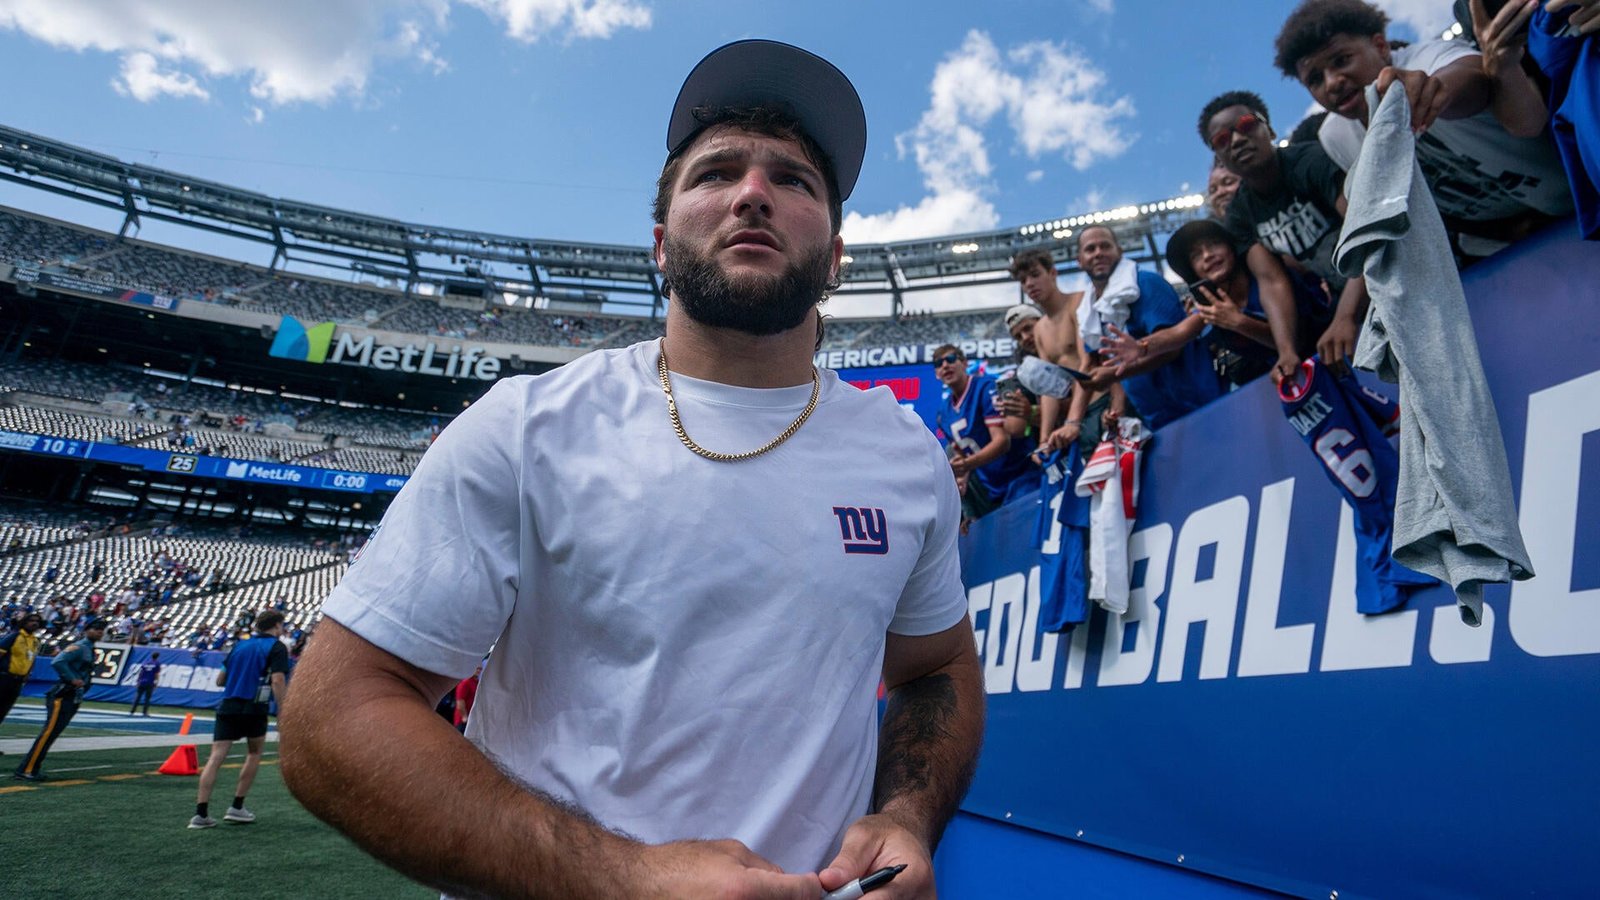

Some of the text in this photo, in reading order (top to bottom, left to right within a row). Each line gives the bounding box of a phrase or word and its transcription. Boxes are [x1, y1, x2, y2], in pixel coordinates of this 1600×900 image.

[331, 332, 501, 380] MetLife
[813, 345, 918, 370] MERICAN
[1288, 392, 1334, 437] DART
[42, 439, 66, 453] 10
[171, 457, 194, 471] 25
[249, 466, 302, 482] MetLife
[333, 474, 366, 488] 0:00
[1315, 427, 1379, 498] 6
